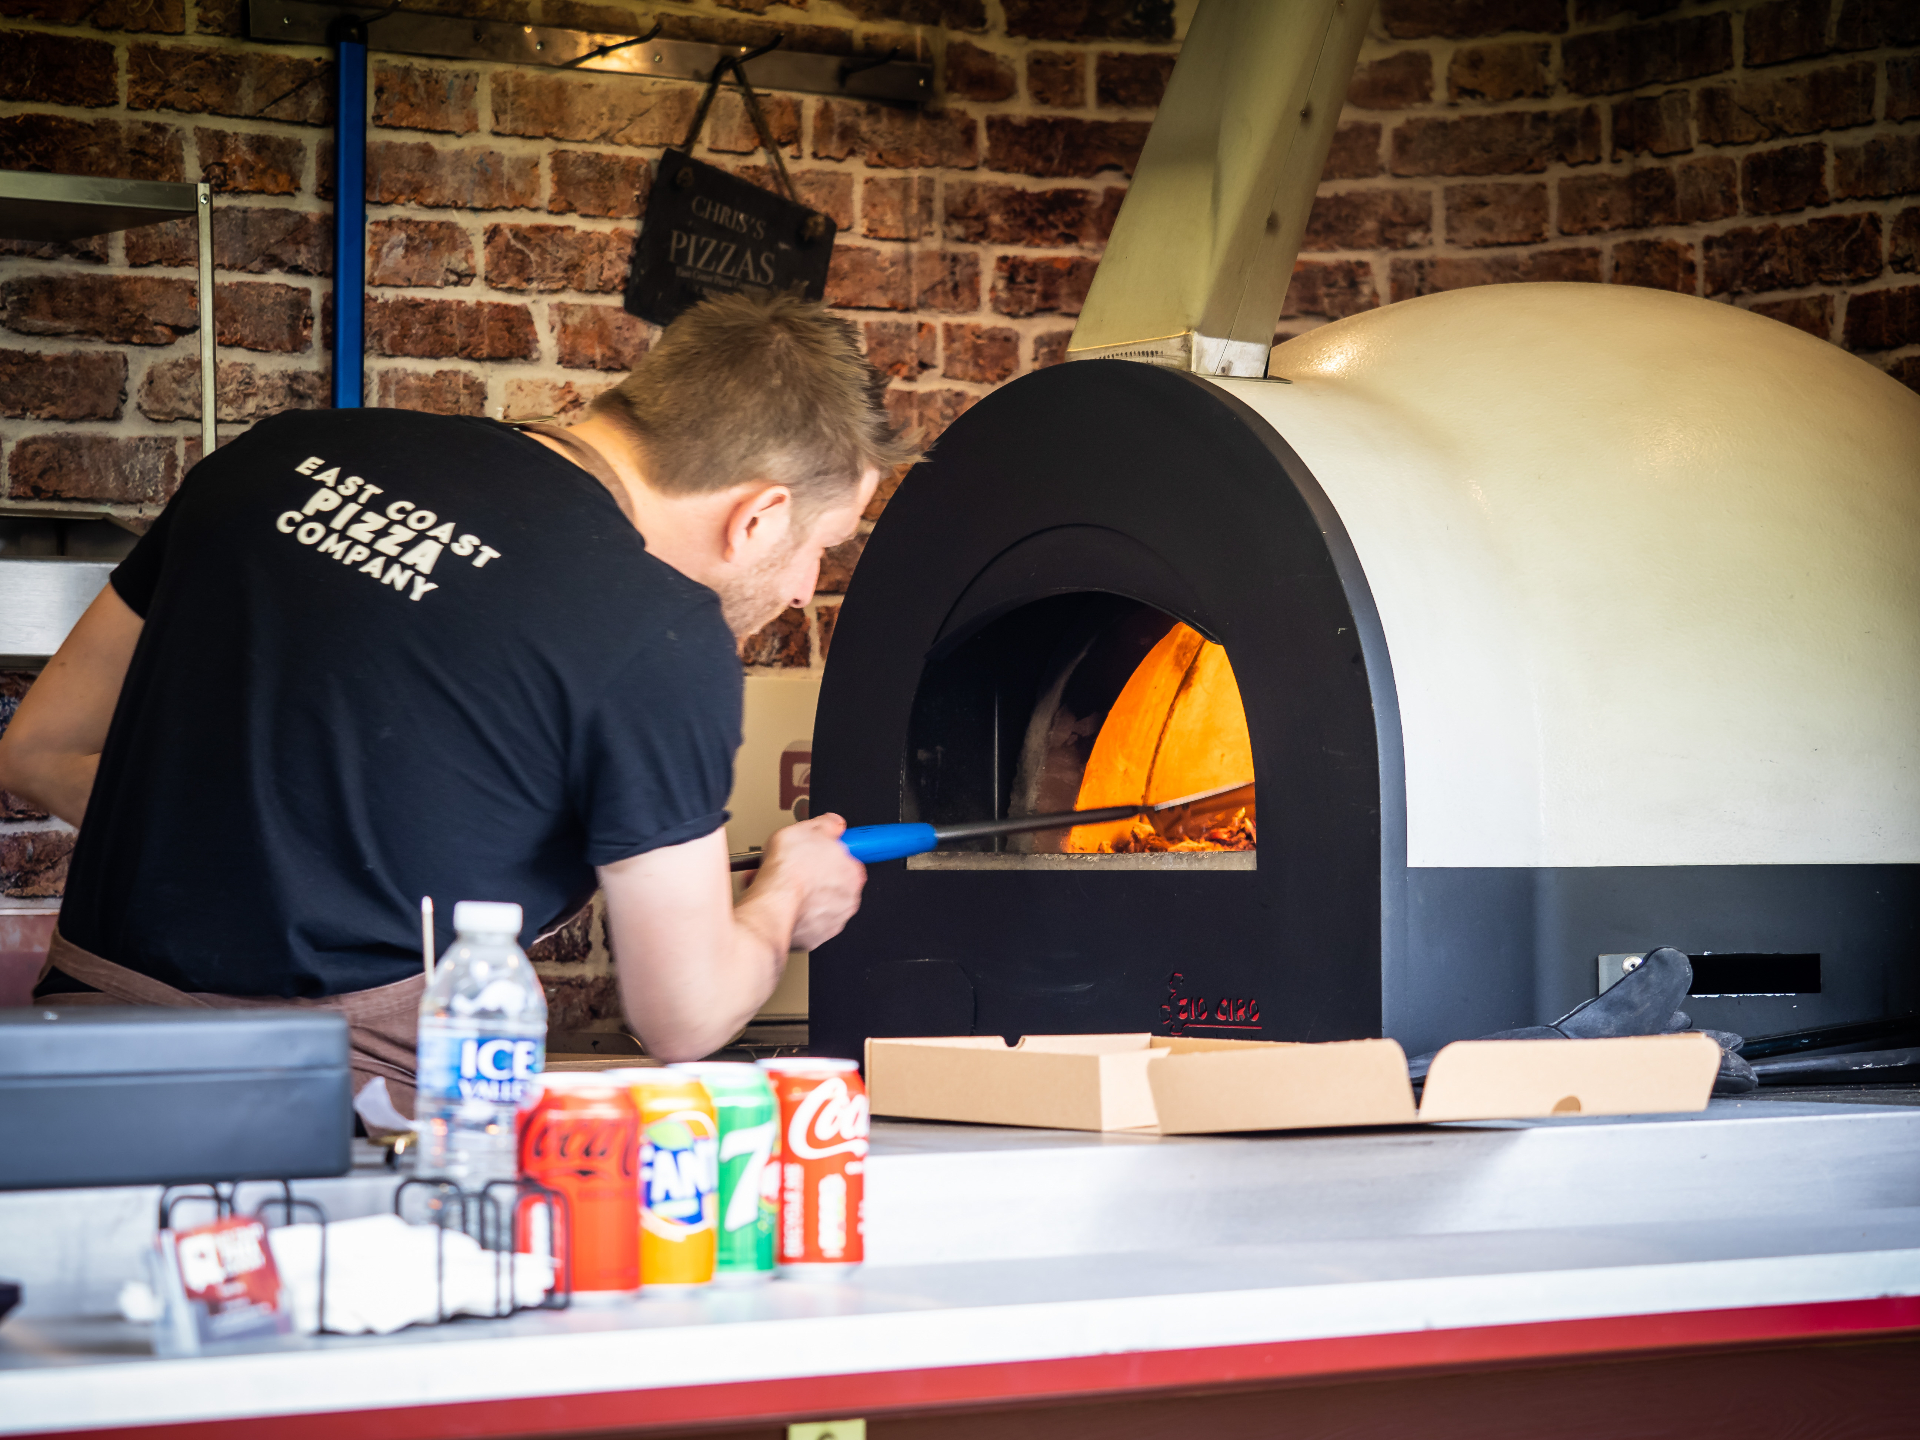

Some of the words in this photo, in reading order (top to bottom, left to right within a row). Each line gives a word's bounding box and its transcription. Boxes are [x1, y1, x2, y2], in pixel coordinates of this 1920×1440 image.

[691, 196, 767, 240] CHRIS'S
[668, 229, 776, 285] PIZZAS
[294, 456, 384, 503] EAST
[385, 500, 501, 568] COAST
[301, 487, 444, 574] PIZZA
[276, 510, 439, 601] COMPANY
[460, 1037, 535, 1081] ICE
